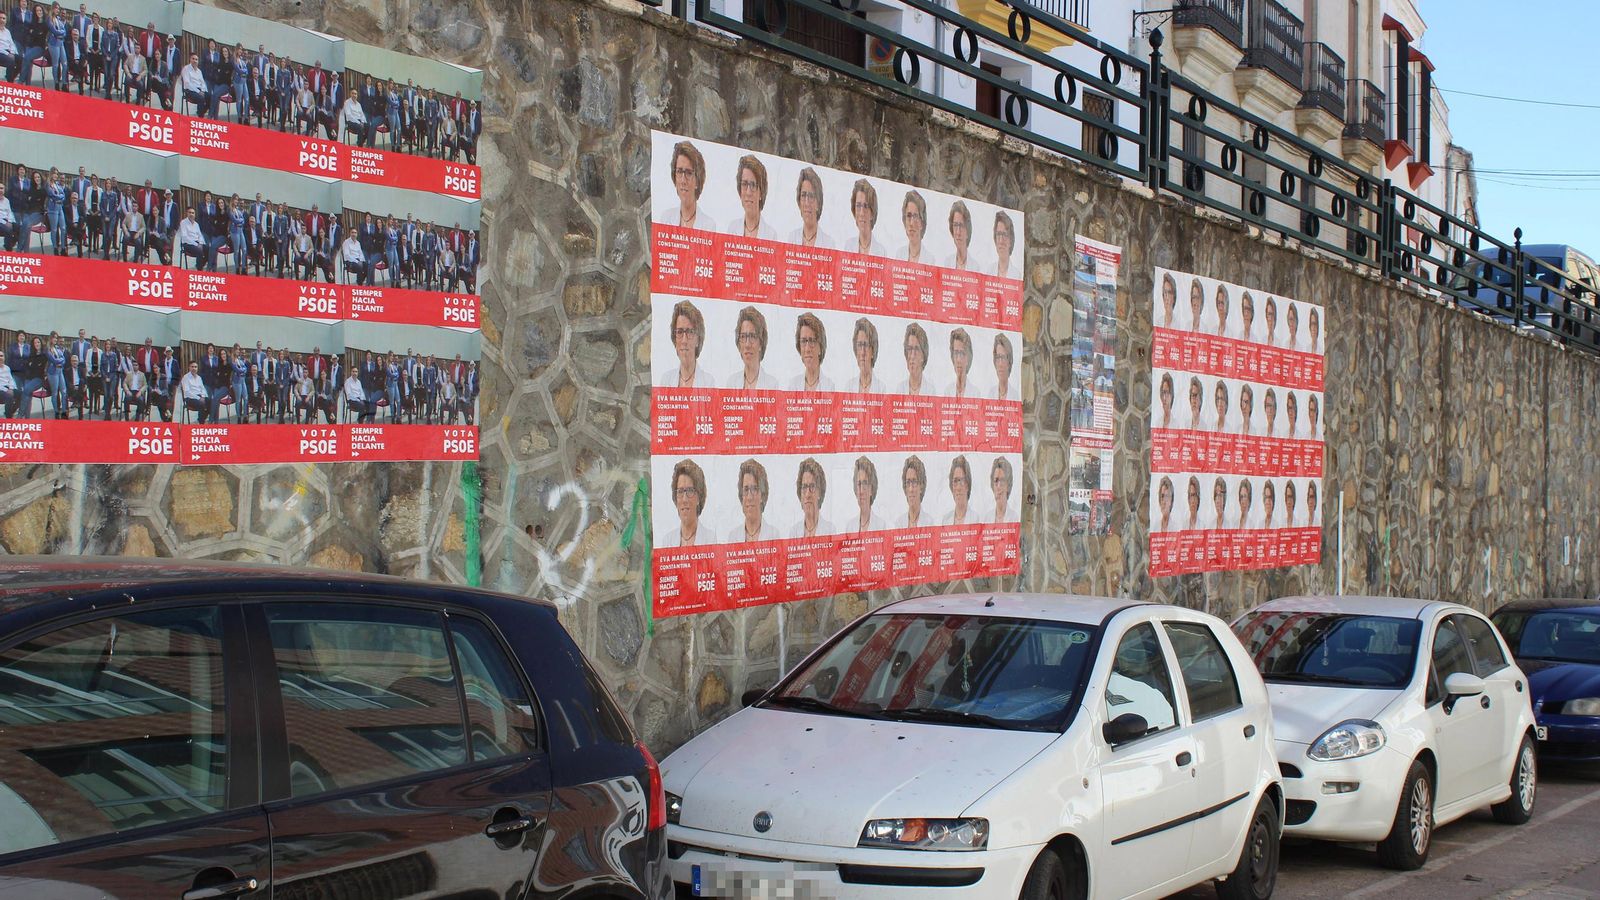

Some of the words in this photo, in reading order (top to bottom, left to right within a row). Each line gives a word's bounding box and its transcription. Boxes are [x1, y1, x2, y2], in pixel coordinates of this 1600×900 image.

[130, 110, 173, 125] VOTA
[190, 121, 228, 134] SIEMPRE
[129, 122, 173, 145] PSOE
[190, 129, 220, 140] HACIA
[190, 137, 230, 150] DELANTE
[301, 141, 338, 155] VOTA
[351, 150, 384, 161] SIEMPRE
[299, 152, 338, 172] PSOE
[351, 158, 376, 168] HACIA
[351, 165, 385, 177] DELANTE
[445, 166, 476, 177] VOTA
[444, 175, 476, 194] PSOE
[658, 240, 690, 250] CONSTANTINA
[690, 236, 712, 246] CASTILLO
[754, 246, 774, 254] CASTILLO
[659, 253, 678, 262] SIEMPRE
[696, 258, 713, 266] VOTA
[659, 260, 674, 268] HACIA
[725, 262, 742, 270] SIEMPRE
[129, 268, 173, 280] VOTA
[659, 267, 679, 276] DELANTE
[695, 266, 713, 278] PSOE
[189, 274, 226, 285] SIEMPRE
[725, 275, 744, 284] DELANTE
[759, 274, 776, 285] PSOE
[128, 280, 173, 299] PSOE
[189, 283, 218, 293] HACIA
[300, 286, 337, 297] VOTA
[817, 281, 833, 292] PSOE
[189, 291, 228, 302] DELANTE
[352, 288, 383, 298] SIEMPRE
[870, 287, 884, 298] PSOE
[352, 296, 376, 305] HACIA
[445, 297, 475, 307] VOTA
[299, 297, 337, 315] PSOE
[352, 304, 385, 313] DELANTE
[444, 306, 476, 323] PSOE
[0, 423, 42, 432] IEMPRE
[130, 426, 173, 437] VOTA
[191, 427, 228, 436] SIEMPRE
[351, 427, 384, 435] SIEMPRE
[696, 424, 713, 434] PSOE
[760, 425, 776, 434] PSOE
[818, 425, 833, 434] PSOE
[871, 426, 884, 435] PSOE
[301, 429, 337, 438] VOTA
[444, 429, 475, 438] VOTA
[191, 436, 220, 444] HACIA
[351, 435, 377, 443] HACIA
[128, 438, 174, 456] PSOE
[191, 444, 231, 453] DELANTE
[300, 439, 337, 455] PSOE
[351, 442, 385, 450] DELANTE
[443, 439, 475, 455] PSOE
[756, 547, 777, 555] CASTILLO
[871, 562, 885, 572] PSOE
[817, 568, 832, 578] PSOE
[660, 575, 678, 583] SIEMPRE
[760, 574, 777, 585] PSOE
[660, 582, 674, 590] HACIA
[697, 581, 715, 592] PSOE
[727, 583, 745, 591] DELANTE
[660, 588, 679, 596] DELANTE
